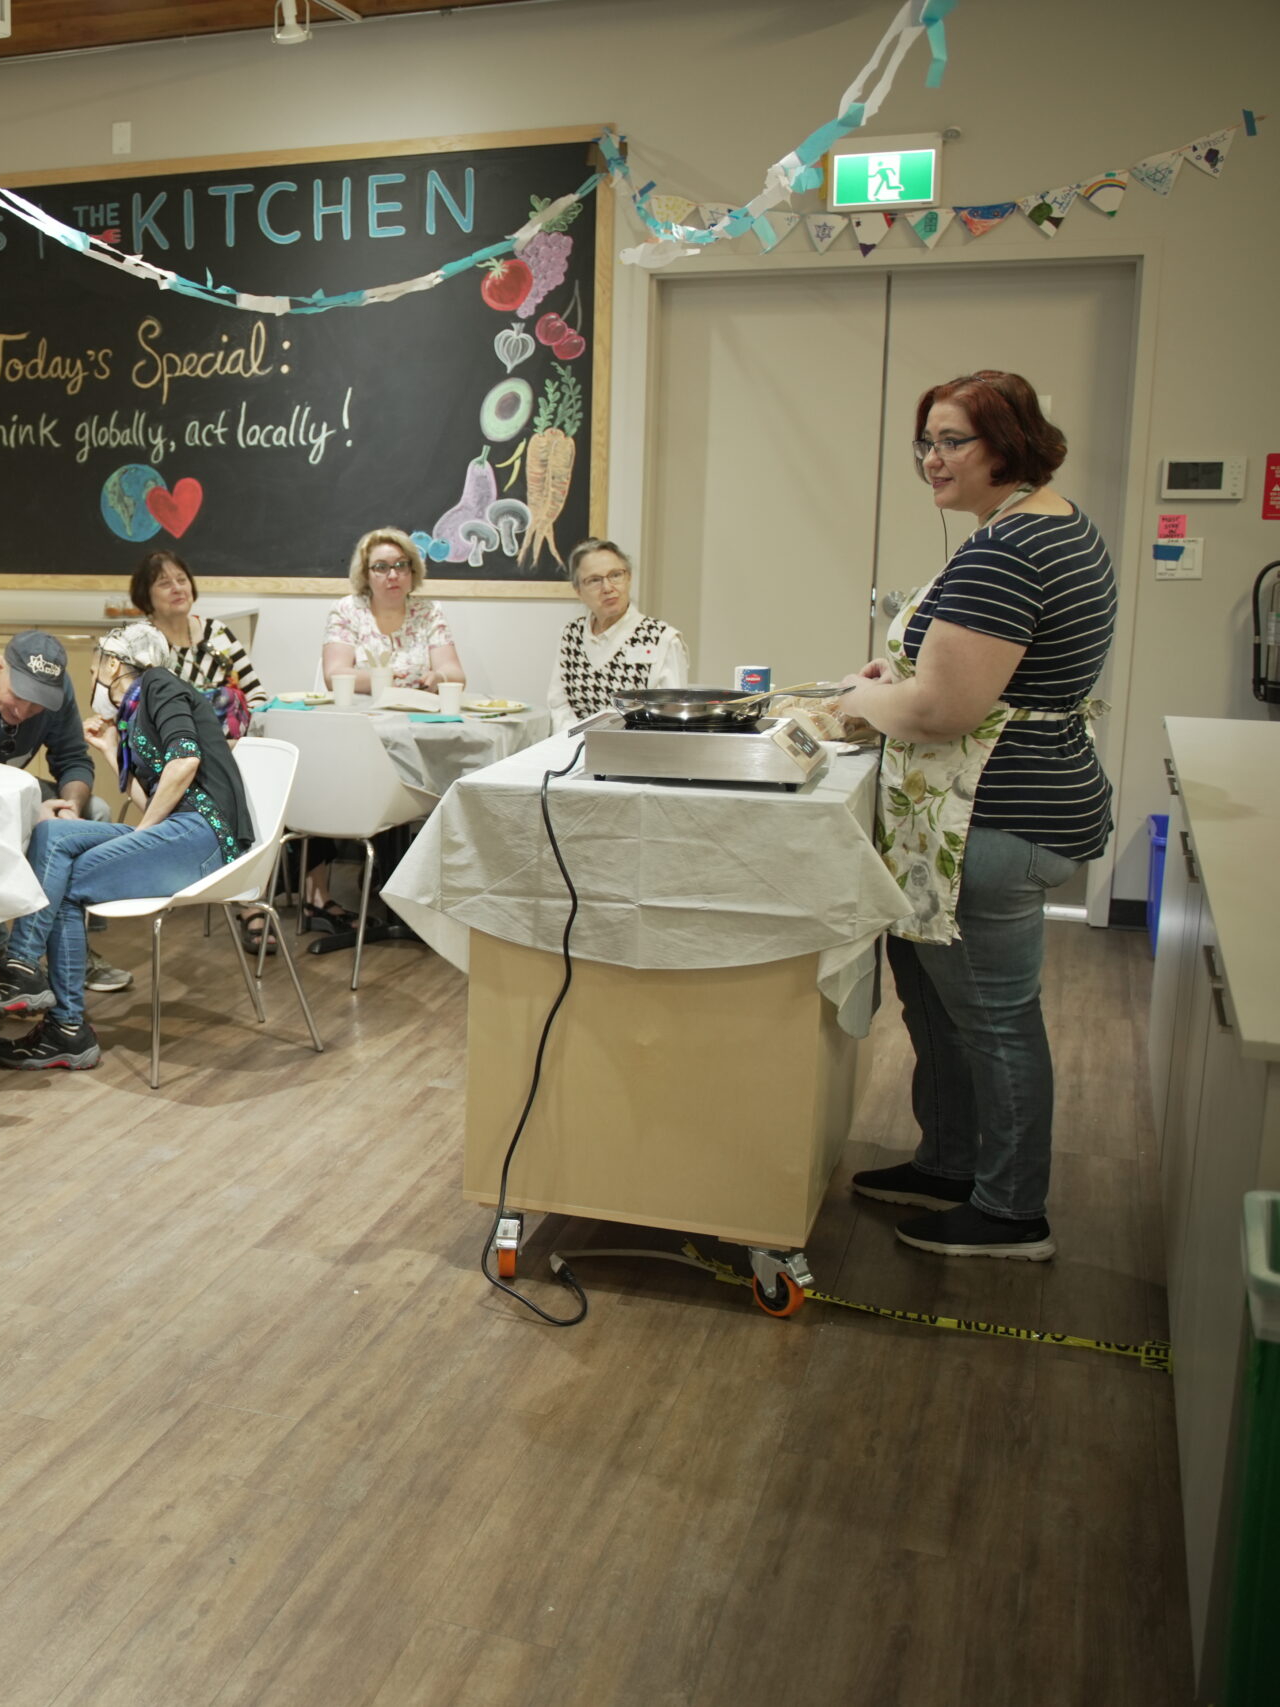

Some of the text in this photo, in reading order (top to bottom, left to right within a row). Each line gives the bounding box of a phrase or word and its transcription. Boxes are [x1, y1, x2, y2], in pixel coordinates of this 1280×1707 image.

[72, 202, 121, 228] THE
[131, 167, 476, 255] KITCHEN
[74, 409, 176, 464] globally,
[184, 410, 228, 447] act
[236, 386, 353, 465] locally!
